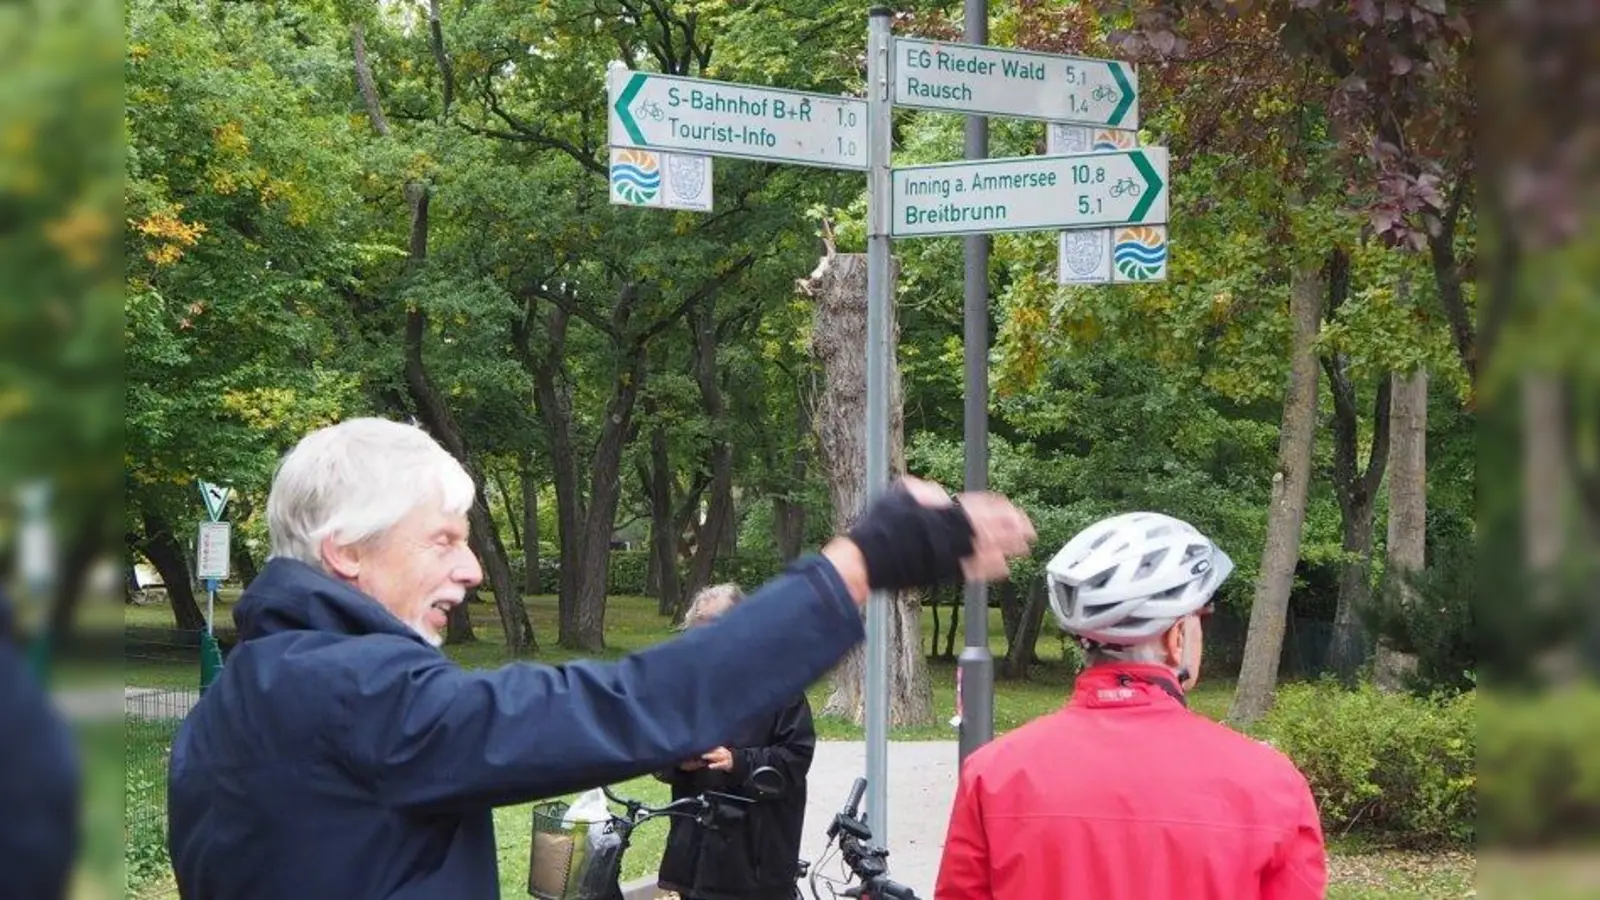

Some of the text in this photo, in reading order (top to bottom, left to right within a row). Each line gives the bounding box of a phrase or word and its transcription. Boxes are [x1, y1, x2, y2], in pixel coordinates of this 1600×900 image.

[906, 49, 932, 69] EG
[936, 51, 996, 75] Rieder
[1001, 58, 1046, 81] Wald
[907, 77, 973, 101] Rausch
[668, 87, 768, 117] S-Bahnhof
[773, 99, 812, 122] B+R
[668, 117, 777, 148] Tourist-Info
[904, 176, 950, 198] Inning
[955, 178, 967, 193] a.
[971, 171, 1057, 191] Ammersee
[905, 203, 1008, 225] Breitbrunn
